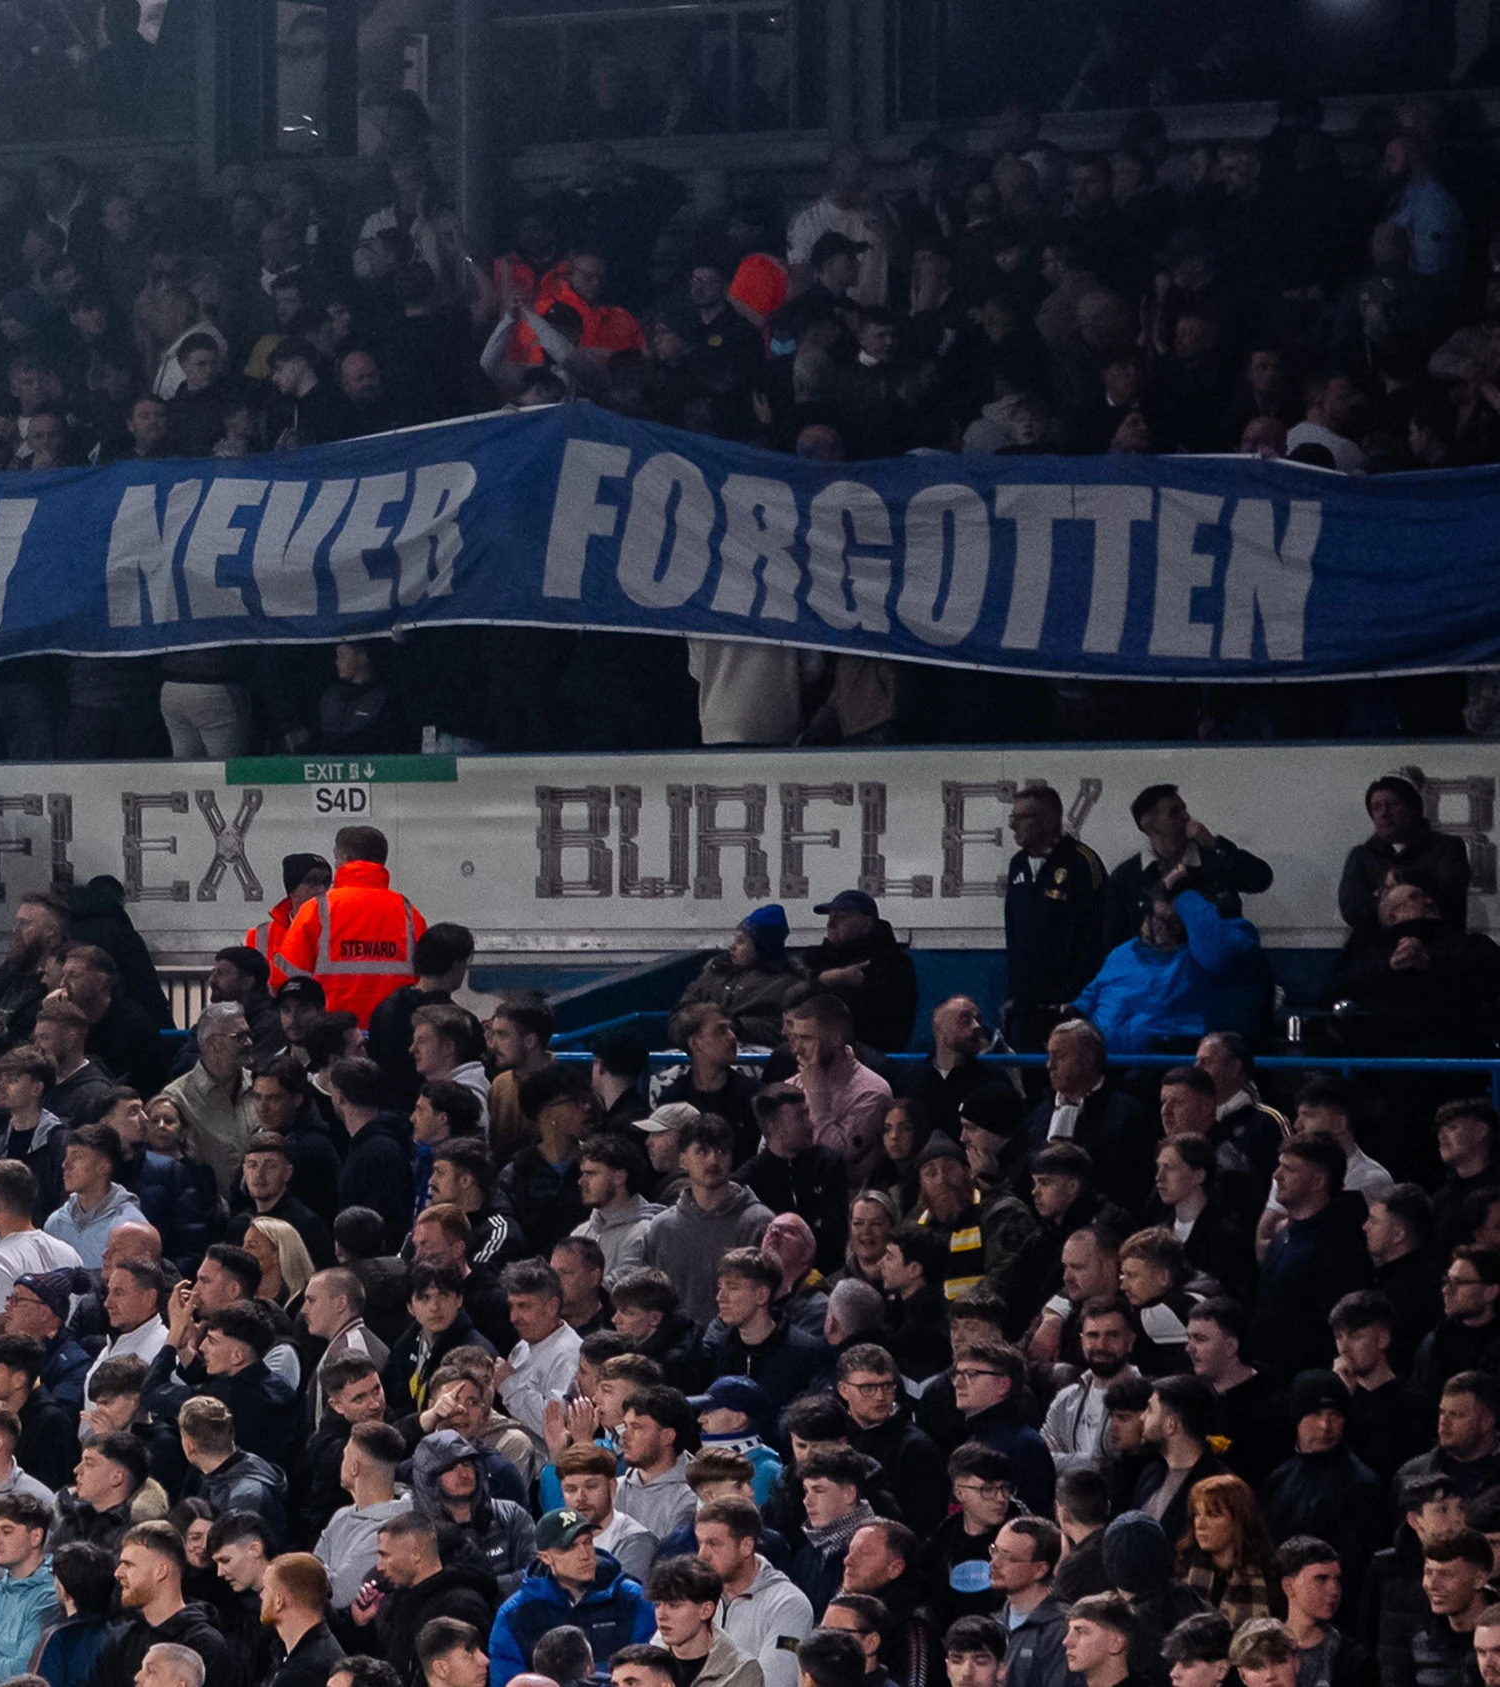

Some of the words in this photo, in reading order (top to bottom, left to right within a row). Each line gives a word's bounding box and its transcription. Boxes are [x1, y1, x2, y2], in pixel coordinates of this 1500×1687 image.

[105, 461, 477, 628] NEVER
[543, 438, 1322, 661] FORGOTTEN
[304, 763, 344, 781] EXIT
[316, 787, 367, 813] S4D
[340, 939, 398, 958] STEWARD
